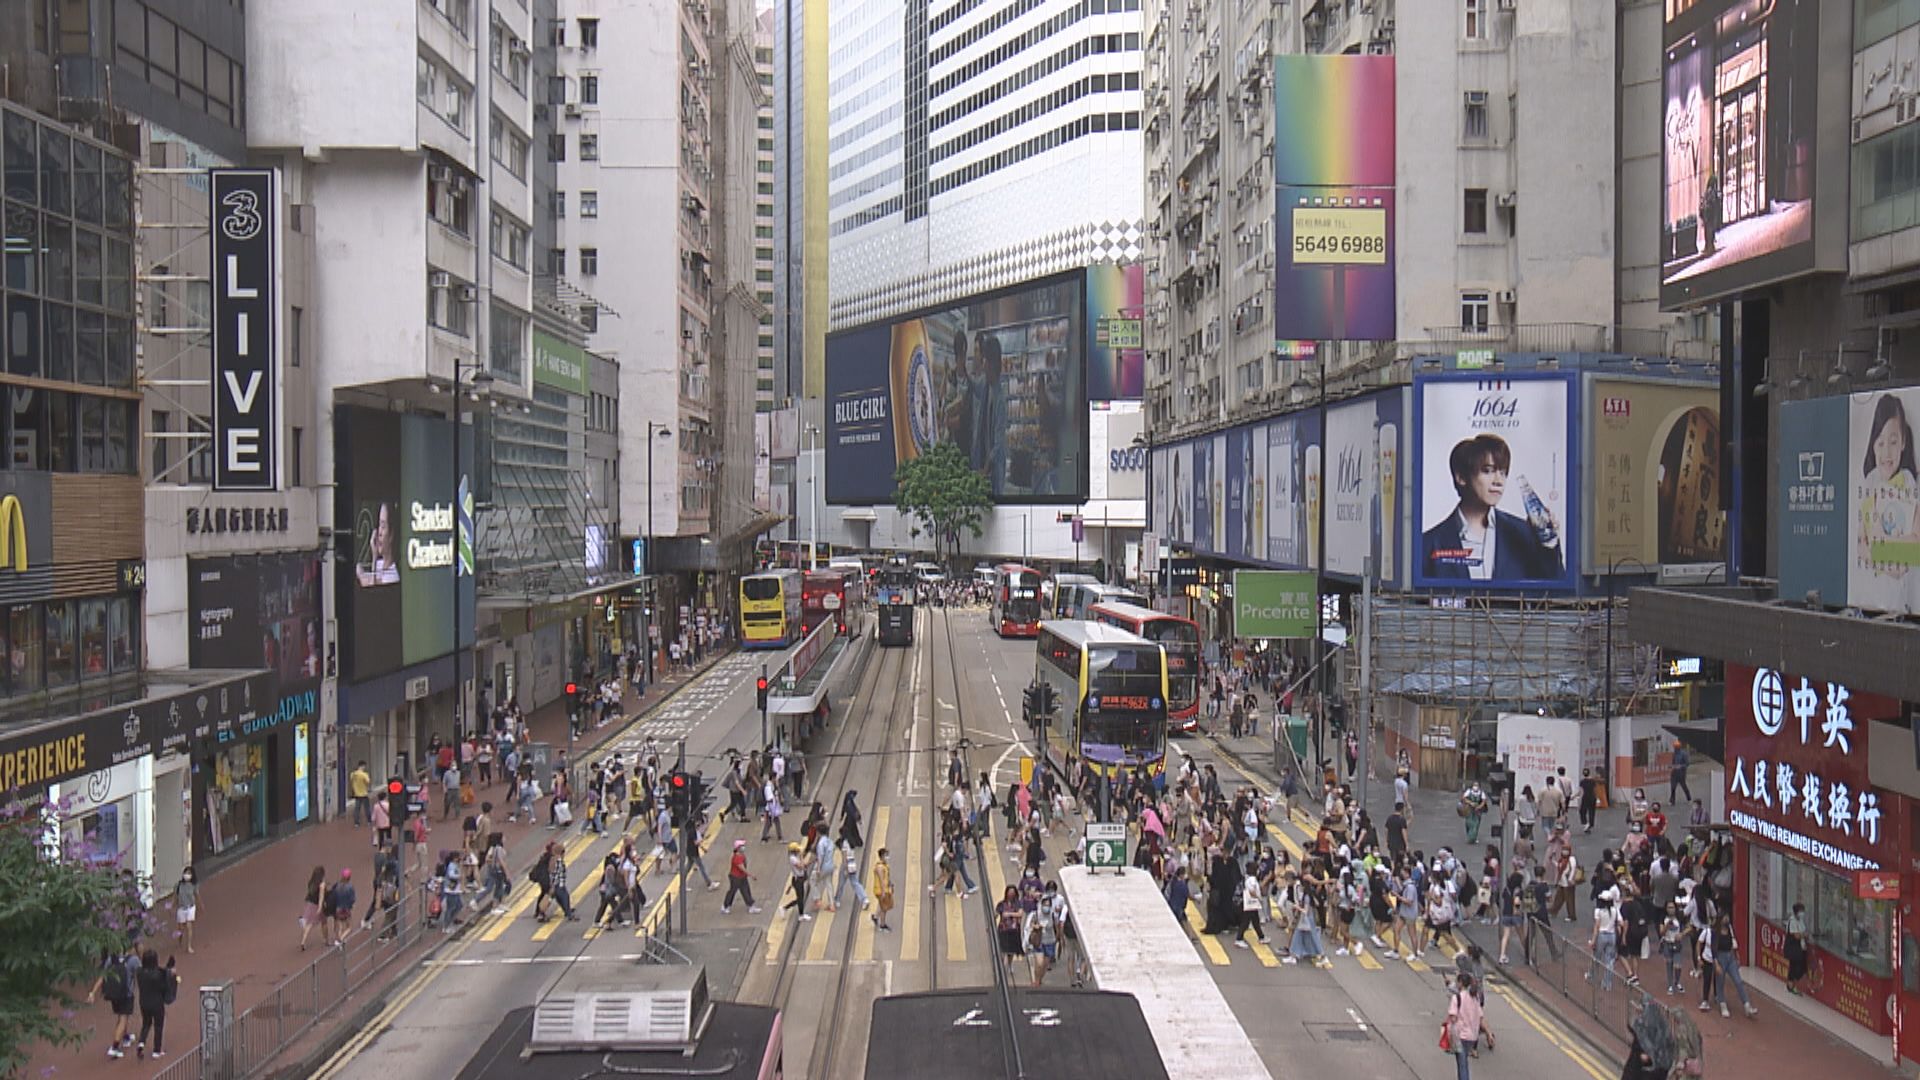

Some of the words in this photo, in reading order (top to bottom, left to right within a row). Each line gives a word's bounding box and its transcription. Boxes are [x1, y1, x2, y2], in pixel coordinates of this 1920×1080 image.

[224, 255, 264, 472] LIVE
[835, 400, 859, 424] BLUE
[860, 396, 886, 420] GIRL
[1473, 397, 1518, 418] 1664
[1110, 447, 1144, 472] SOGO
[411, 501, 453, 532] Standard
[1790, 677, 1854, 755] 中英
[1730, 755, 1881, 845] 人民幣找換行
[1730, 809, 1756, 831] CHUNG
[1757, 817, 1777, 839] YING
[1777, 823, 1810, 853] REMINBI
